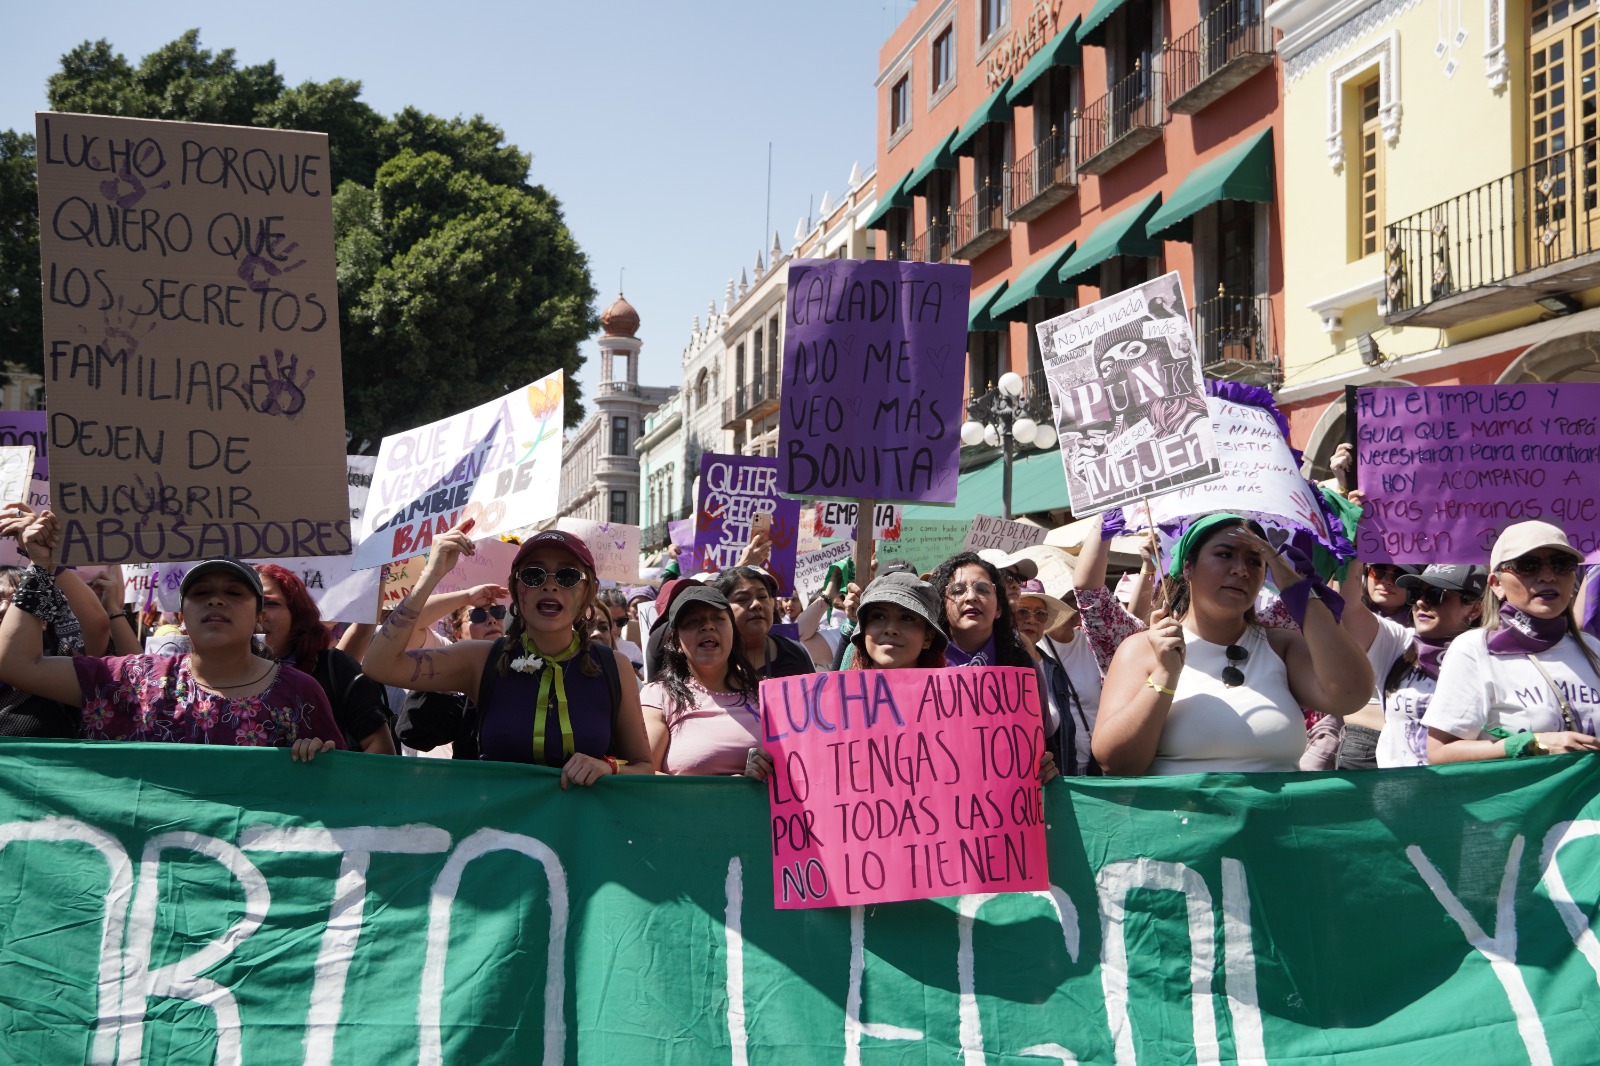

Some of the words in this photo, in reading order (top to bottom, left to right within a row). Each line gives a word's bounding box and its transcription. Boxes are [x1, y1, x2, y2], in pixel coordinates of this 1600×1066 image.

[45, 119, 165, 177] LUCHO
[182, 140, 321, 197] PORQUE
[53, 196, 193, 256] QUIERO
[207, 212, 288, 261] QUE
[50, 262, 114, 310] LOS
[128, 278, 327, 333] SECRETOS
[793, 269, 942, 326] CALLADITA
[1058, 332, 1076, 349] No
[1078, 313, 1107, 337] hay
[1109, 298, 1144, 323] nada
[1149, 320, 1178, 336] más
[50, 341, 307, 416] FAMILIARES
[793, 338, 838, 387] NO
[863, 339, 912, 385] ME
[790, 395, 844, 438] VEO
[872, 390, 946, 441] MÁS
[1073, 359, 1191, 426] PUNK
[1405, 391, 1430, 416] el
[51, 412, 165, 466] DEJEN
[187, 429, 252, 475] DE
[386, 421, 452, 472] QUE
[463, 399, 515, 450] LA
[1216, 440, 1273, 452] ESISTIÓ
[1415, 421, 1460, 440] QUE
[707, 462, 777, 497] QUIER
[787, 438, 933, 494] BONITA
[1382, 471, 1417, 493] HOY
[1438, 468, 1545, 490] ACOMPAÑO
[1563, 470, 1581, 486] A
[59, 481, 261, 520] ENCUBRIR
[372, 481, 473, 532] CAMBIE
[494, 459, 536, 499] DE
[825, 503, 894, 528] EMPIA
[60, 517, 353, 564] ABUSADORES
[392, 501, 507, 559] BANDO
[806, 541, 851, 563] VIOLADORES
[976, 516, 991, 532] NO
[991, 519, 1040, 543] DEBERIA
[761, 672, 905, 742] LUCHA
[917, 671, 1040, 723] AUNQUE
[1554, 679, 1600, 705] MIED
[772, 750, 809, 805] LO
[827, 730, 960, 796] TENGAS
[972, 725, 1044, 781] TODO
[772, 809, 824, 856] POR
[835, 796, 939, 843] TODAS
[955, 790, 1003, 830] LAS
[1011, 786, 1044, 827] QUE
[782, 858, 829, 902] NO
[845, 850, 886, 894] LO
[903, 831, 1033, 889] TIENEN.
